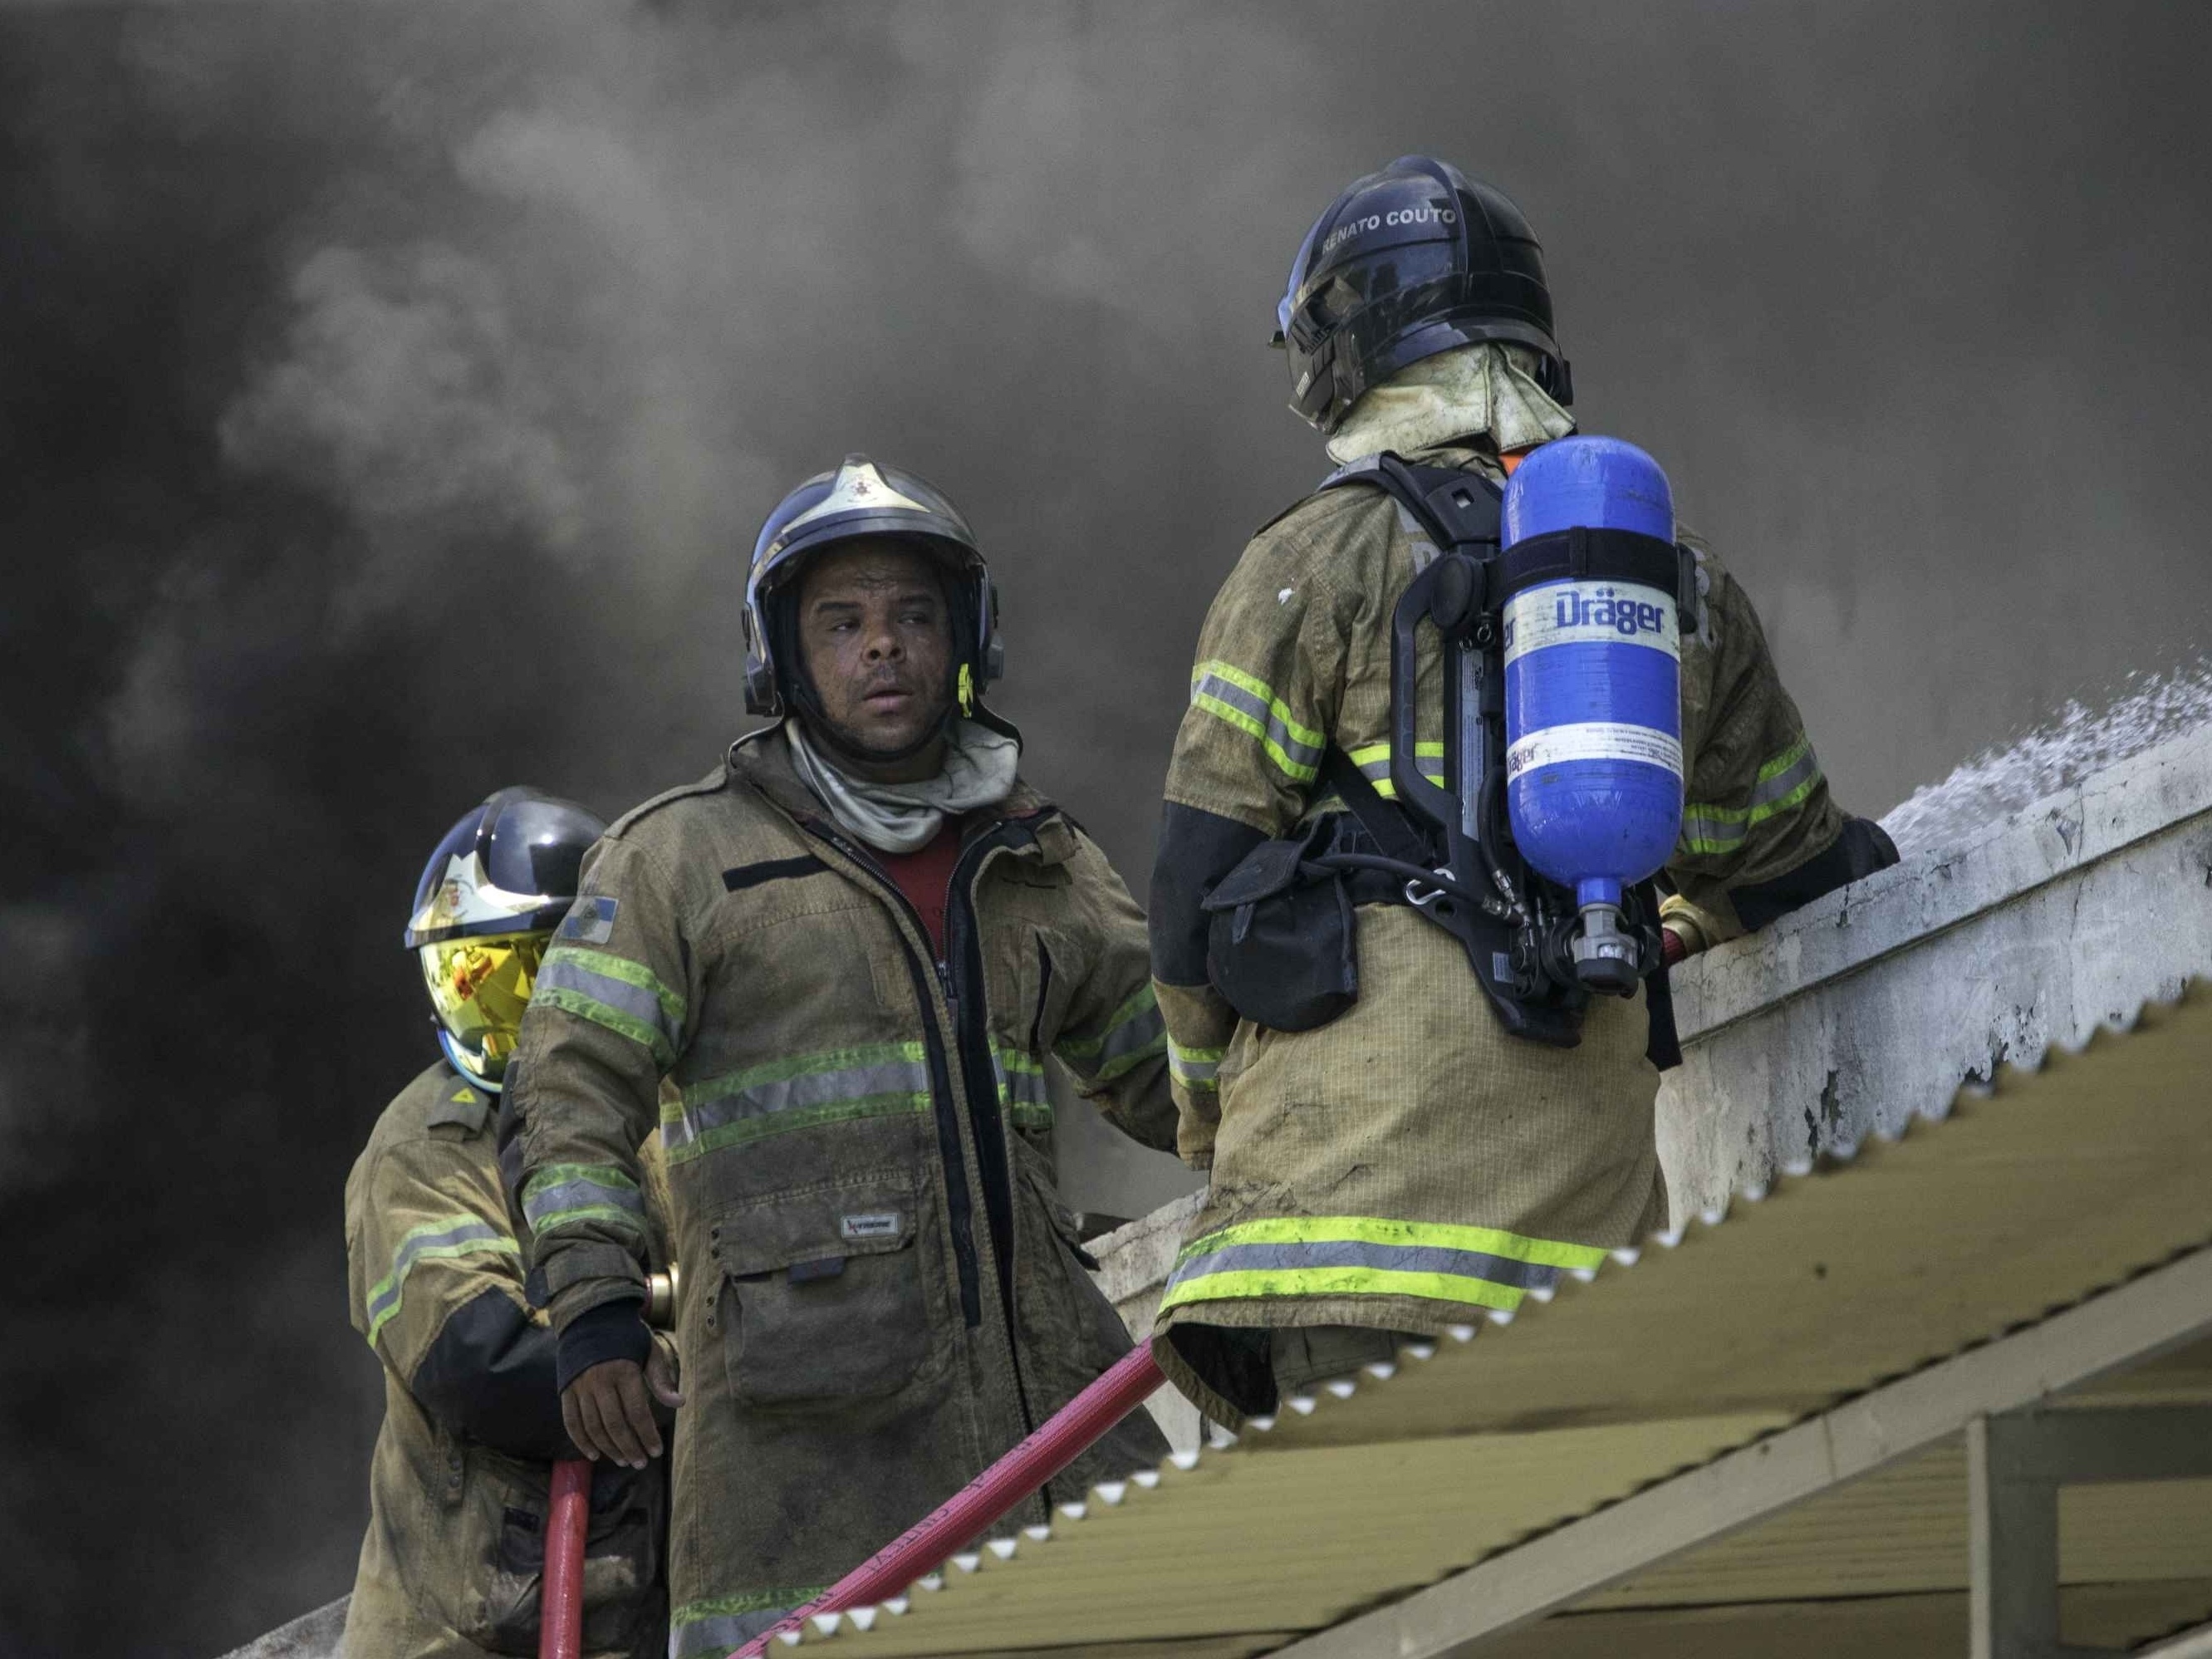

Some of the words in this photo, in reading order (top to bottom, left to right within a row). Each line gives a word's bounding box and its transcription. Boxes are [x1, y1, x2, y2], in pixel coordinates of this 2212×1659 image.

[1322, 215, 1381, 254] RENATO
[1386, 208, 1456, 225] COUTO
[1556, 587, 1665, 636] Dräger
